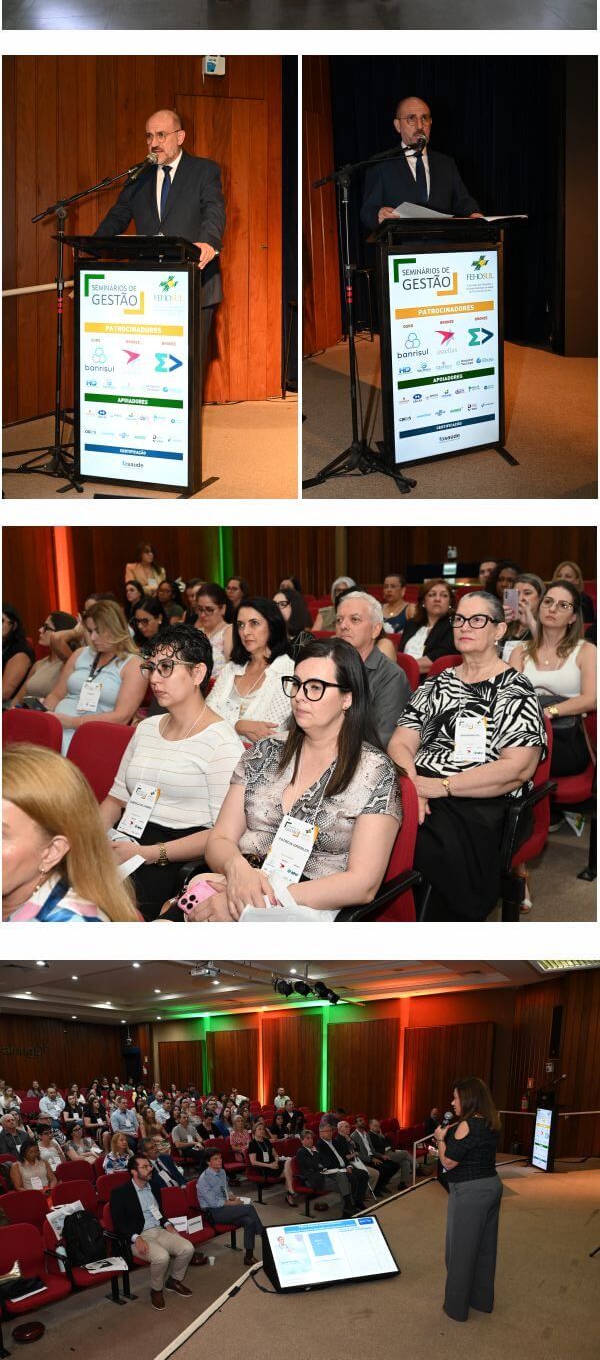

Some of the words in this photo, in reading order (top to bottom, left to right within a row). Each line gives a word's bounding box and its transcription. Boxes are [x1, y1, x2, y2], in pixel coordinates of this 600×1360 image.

[402, 264, 439, 276] SEMINÁRIOS
[92, 283, 127, 292] SEMINÁRIOS
[403, 275, 450, 291] GESTÃO
[92, 292, 138, 306] GESTÃO
[418, 304, 474, 316] PATROCINADORES
[105, 325, 162, 334] PATROCINADORES
[397, 349, 428, 359] banrisul
[85, 364, 114, 372] banrisul
[433, 374, 463, 383] APOIADORES
